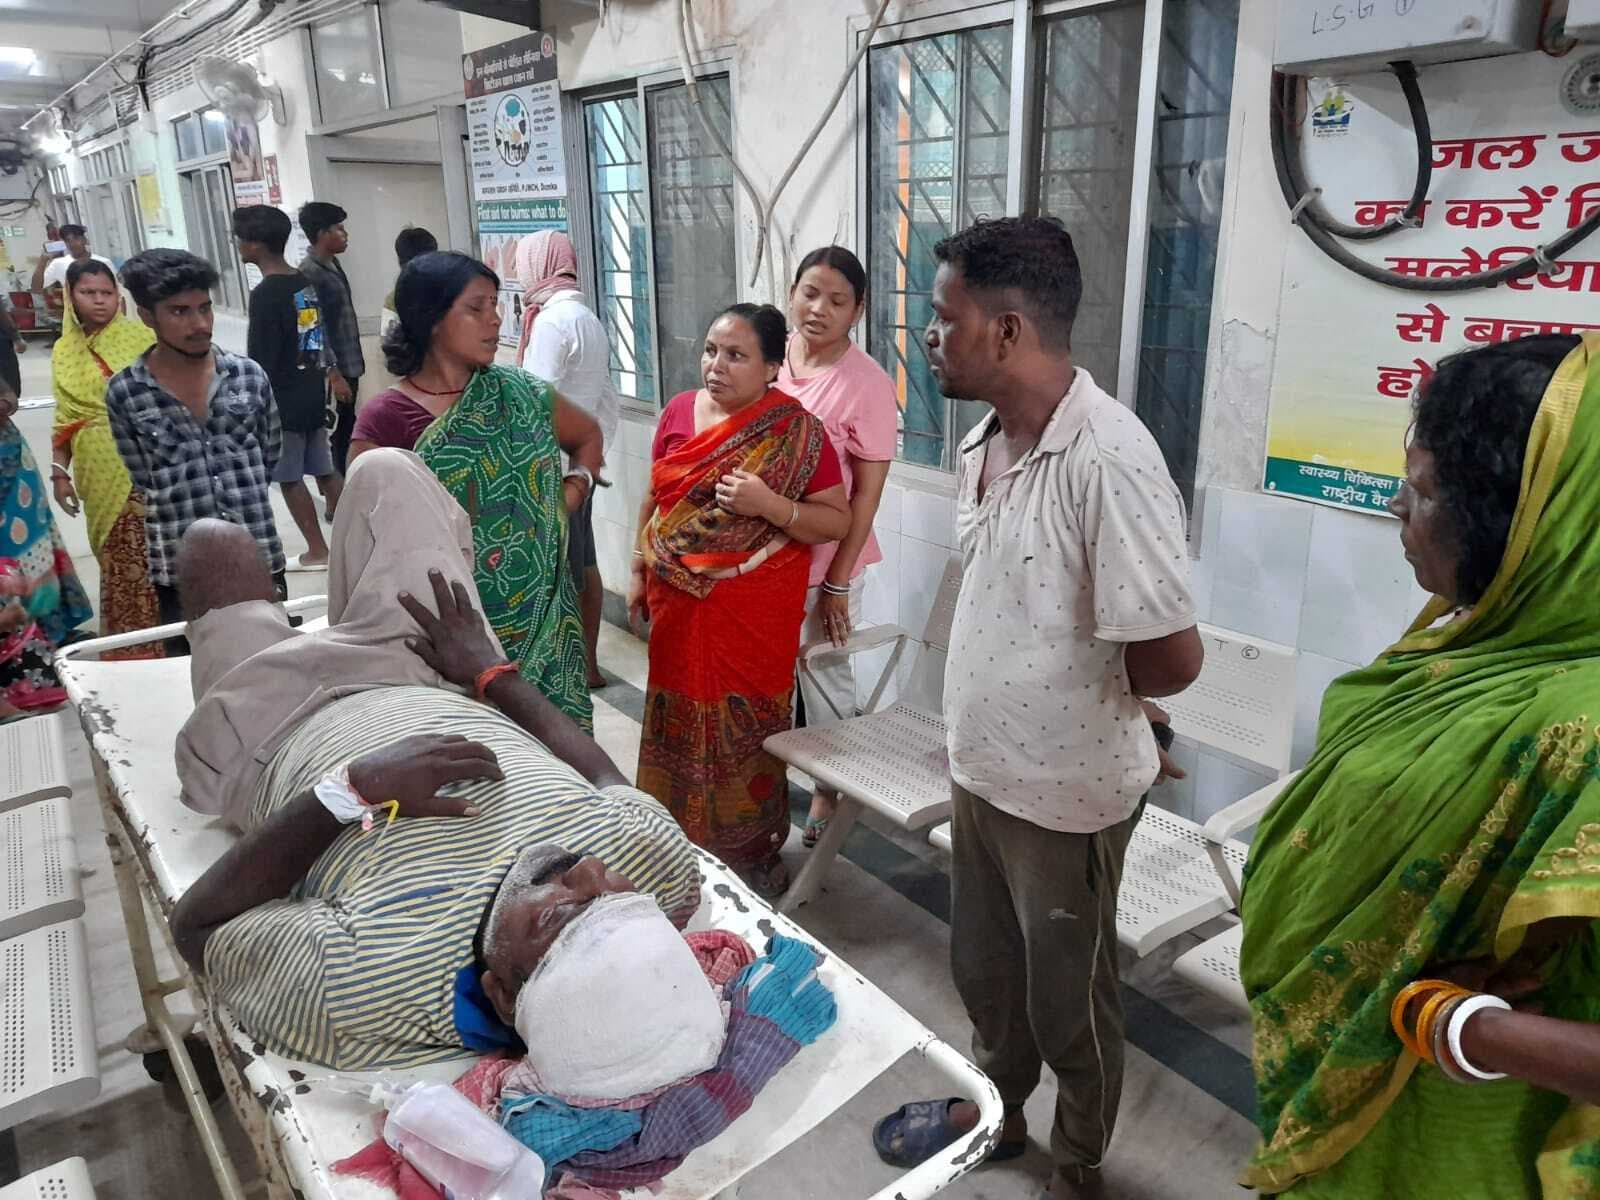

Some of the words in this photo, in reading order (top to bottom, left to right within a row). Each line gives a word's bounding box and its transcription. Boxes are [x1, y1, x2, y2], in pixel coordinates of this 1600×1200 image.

[531, 204, 548, 218] what
[549, 204, 556, 218] to
[557, 199, 566, 218] do
[1445, 185, 1559, 229] करें
[1396, 303, 1450, 343] से
[1298, 464, 1340, 481] स्वास्थ्य
[1343, 469, 1393, 490] चिकित्सा
[1321, 485, 1367, 504] राष्ट्रीय
